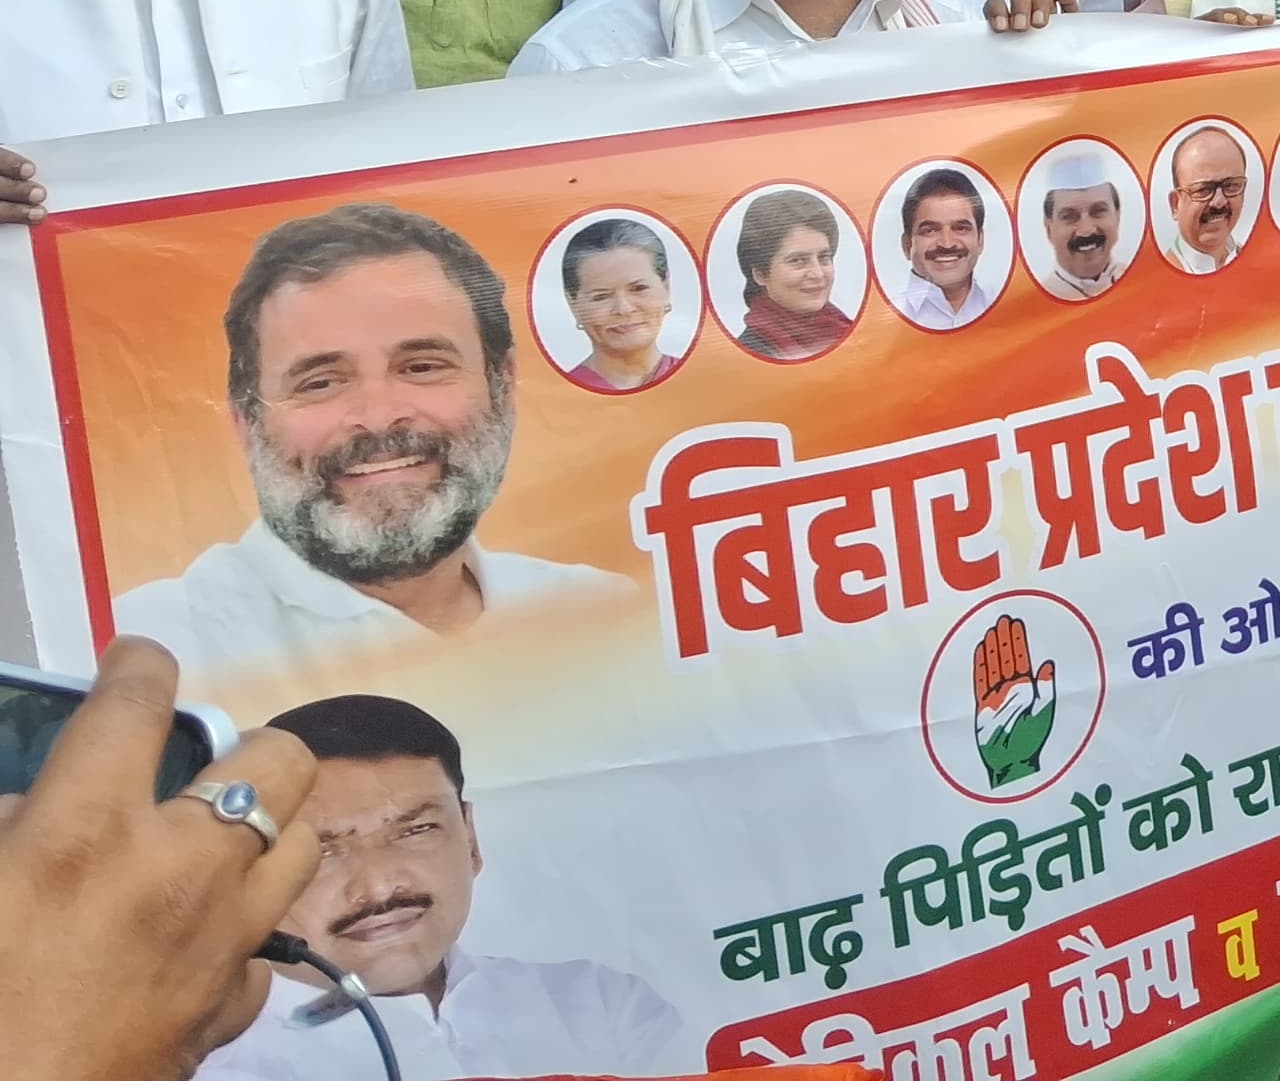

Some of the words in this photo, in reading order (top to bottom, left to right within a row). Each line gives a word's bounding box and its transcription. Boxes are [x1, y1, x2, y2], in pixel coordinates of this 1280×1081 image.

[645, 437, 1001, 658] बिहार
[1014, 355, 1257, 570] प्रदेश
[1127, 602, 1205, 679] की
[713, 893, 864, 990] बाढ़
[880, 783, 1113, 949] पिड़ितों
[1122, 753, 1214, 852] को
[1048, 924, 1200, 1051] कैम्प
[1217, 909, 1261, 981] व
